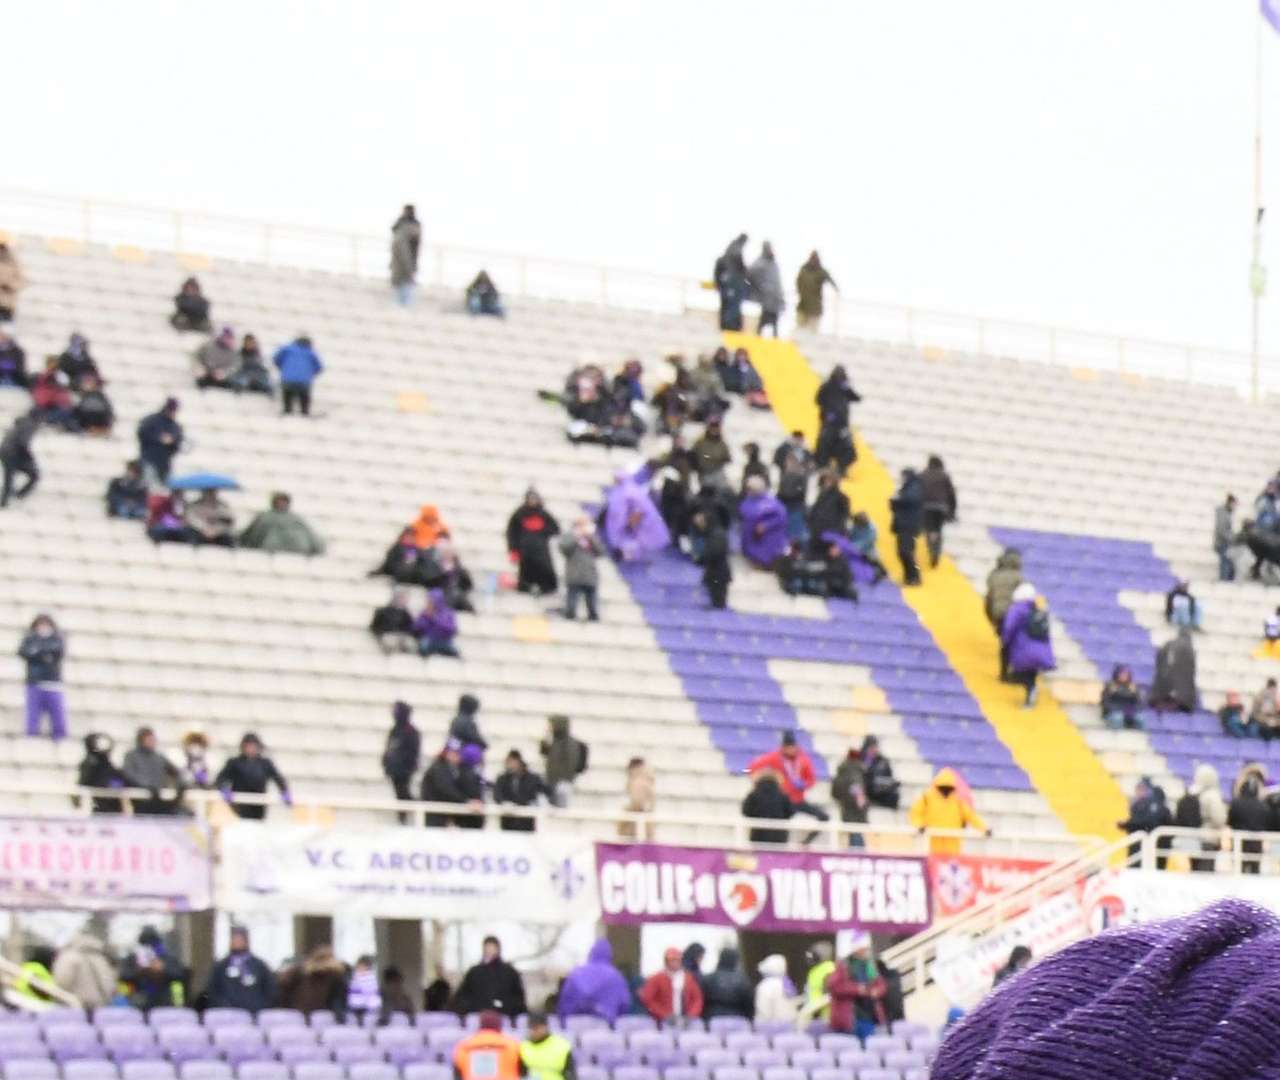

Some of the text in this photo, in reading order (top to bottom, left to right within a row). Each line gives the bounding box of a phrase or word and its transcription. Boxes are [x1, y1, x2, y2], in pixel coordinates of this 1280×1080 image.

[370, 851, 532, 875] ARCIDOSSO
[601, 860, 697, 915] COLLE
[770, 868, 828, 922] VAL
[830, 872, 929, 924] D'ELSA
